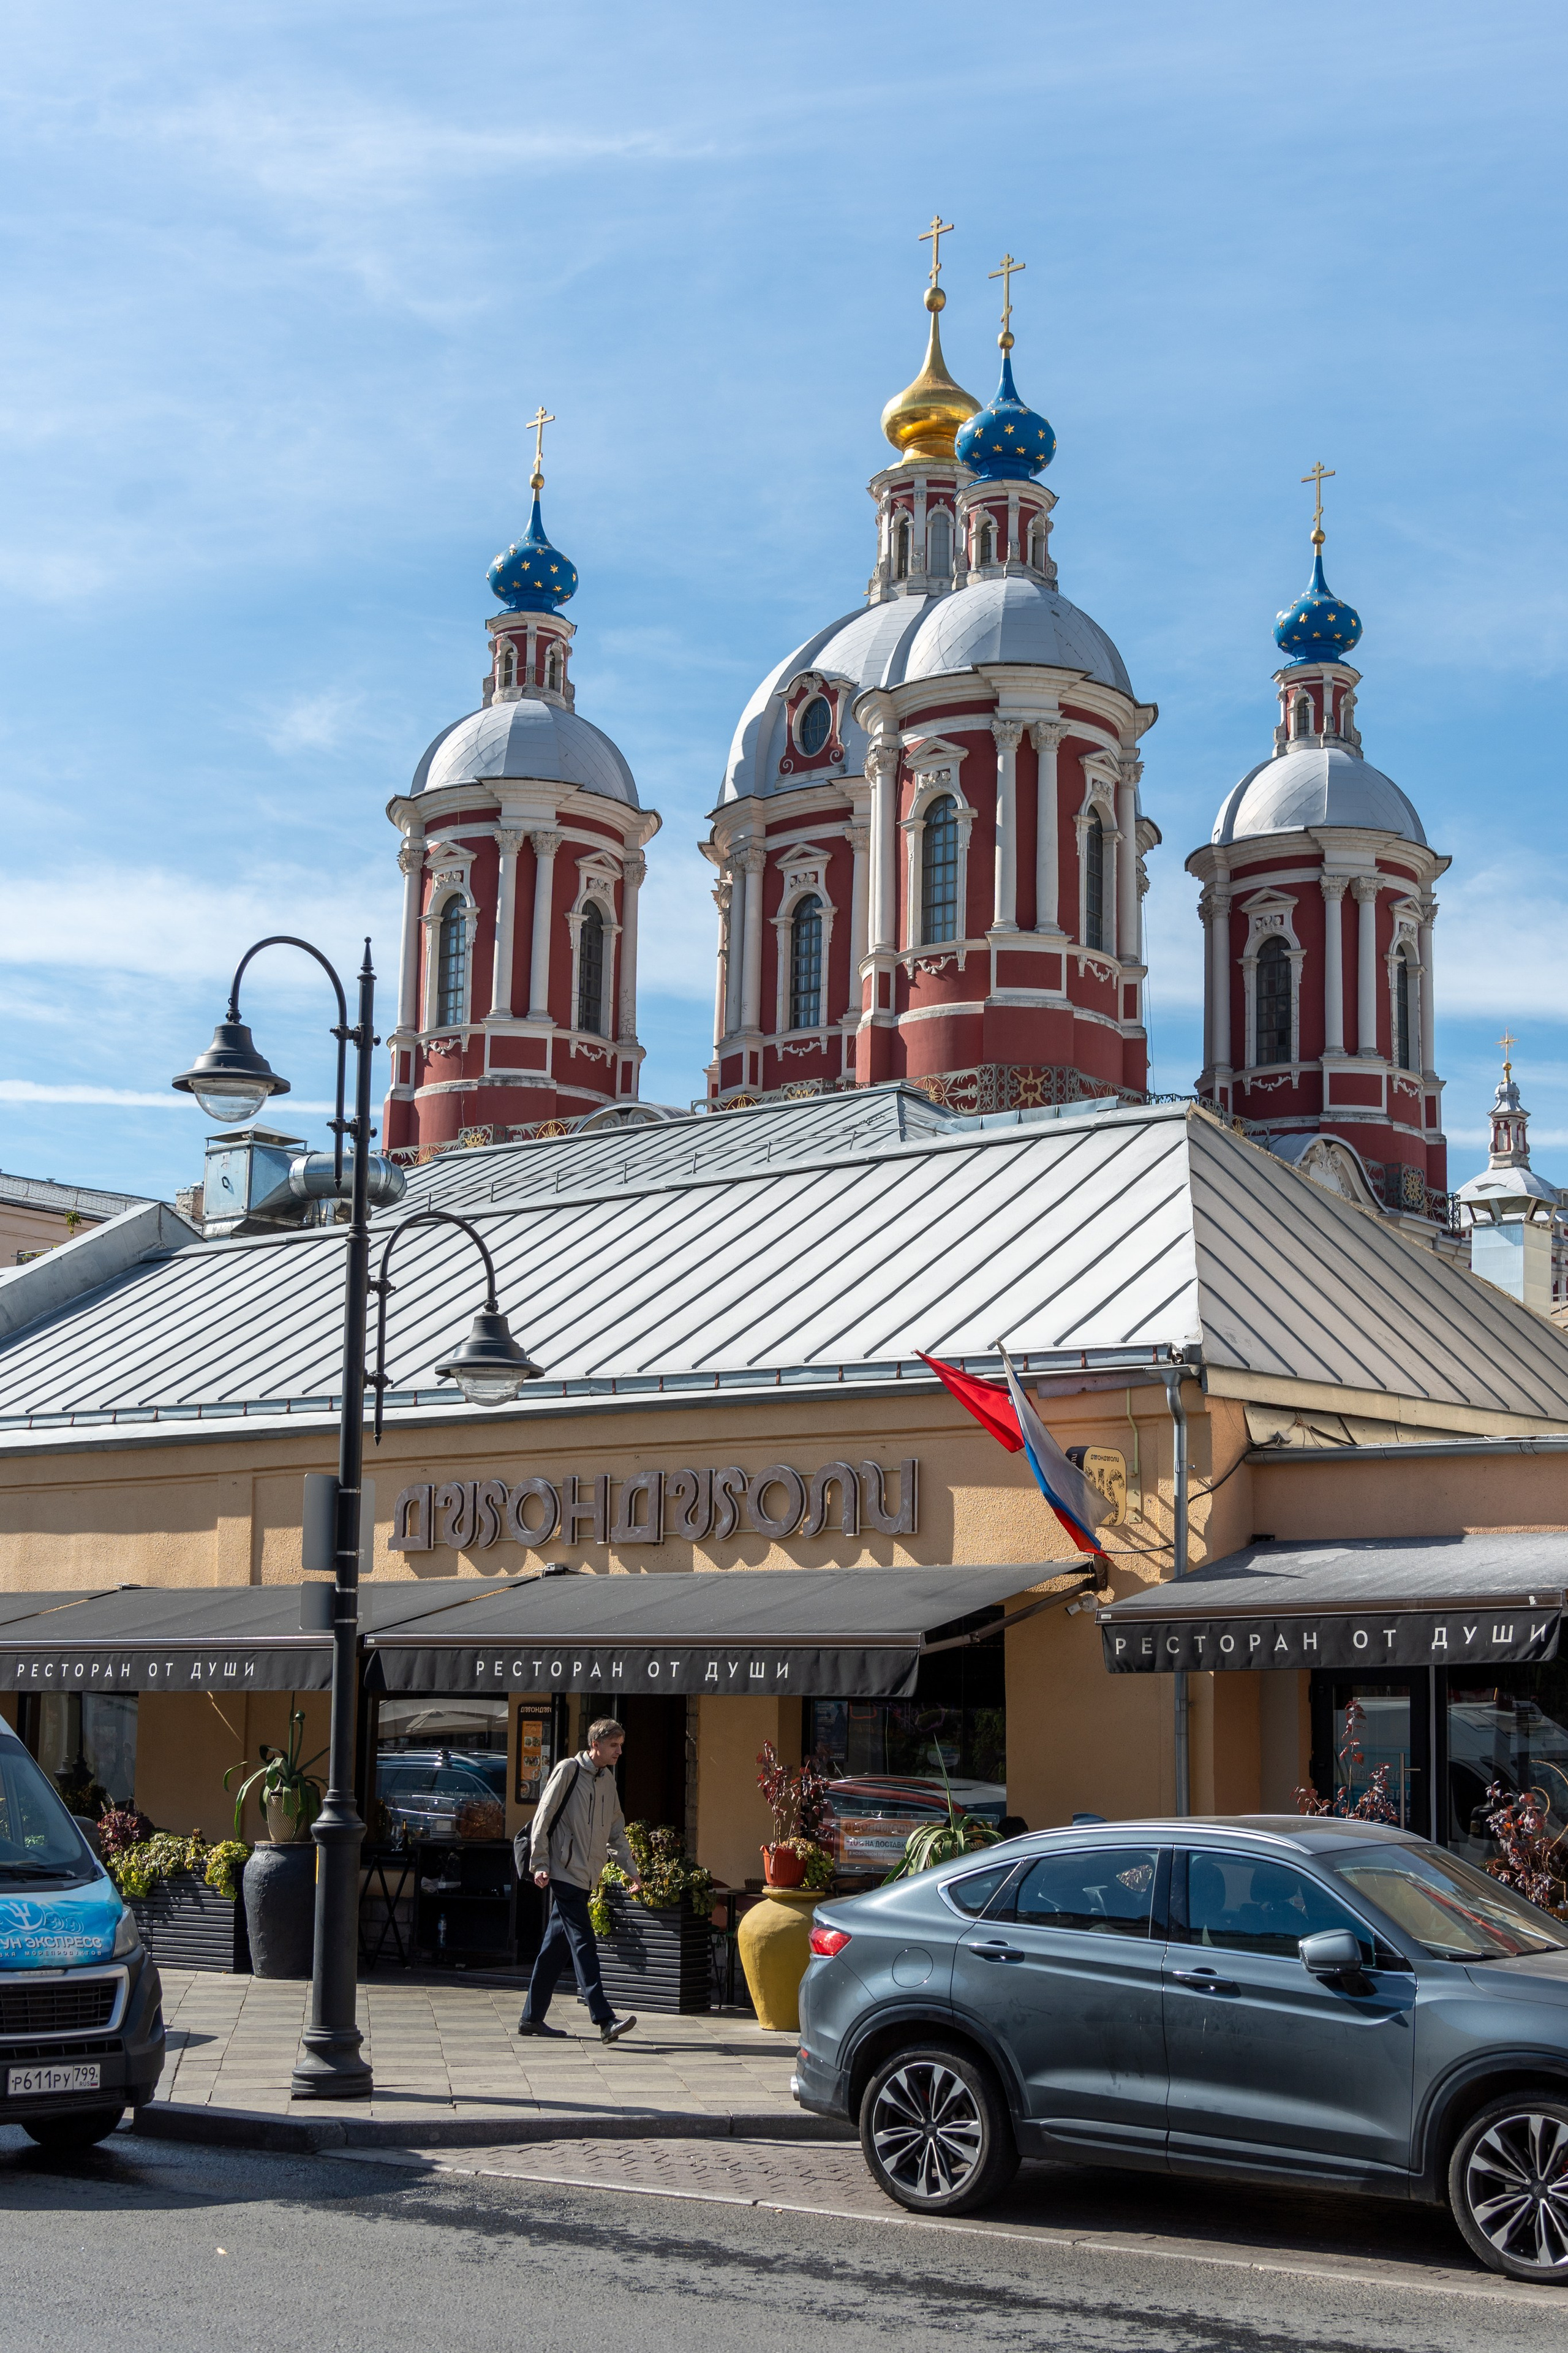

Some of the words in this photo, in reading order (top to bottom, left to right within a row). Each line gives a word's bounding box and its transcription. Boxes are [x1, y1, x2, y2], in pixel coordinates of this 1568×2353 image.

[1115, 1632, 1317, 1655] РЕСТОРАН
[1353, 1629, 1396, 1649] ОТ
[1431, 1623, 1547, 1650] ДУШИ
[17, 1663, 130, 1677] РЕСТОРАН
[148, 1663, 173, 1677] ОТ
[190, 1662, 254, 1679] ДУШИ
[477, 1661, 622, 1677] РЕСТОРАН
[647, 1661, 680, 1678] ОТ
[704, 1661, 789, 1681] ДУШИ
[875, 1840, 907, 1849] ДОСТАВК
[0, 1938, 23, 1949] УН
[24, 1936, 103, 1949] ЭКСПРЕСС
[74, 2066, 96, 2082] 799
